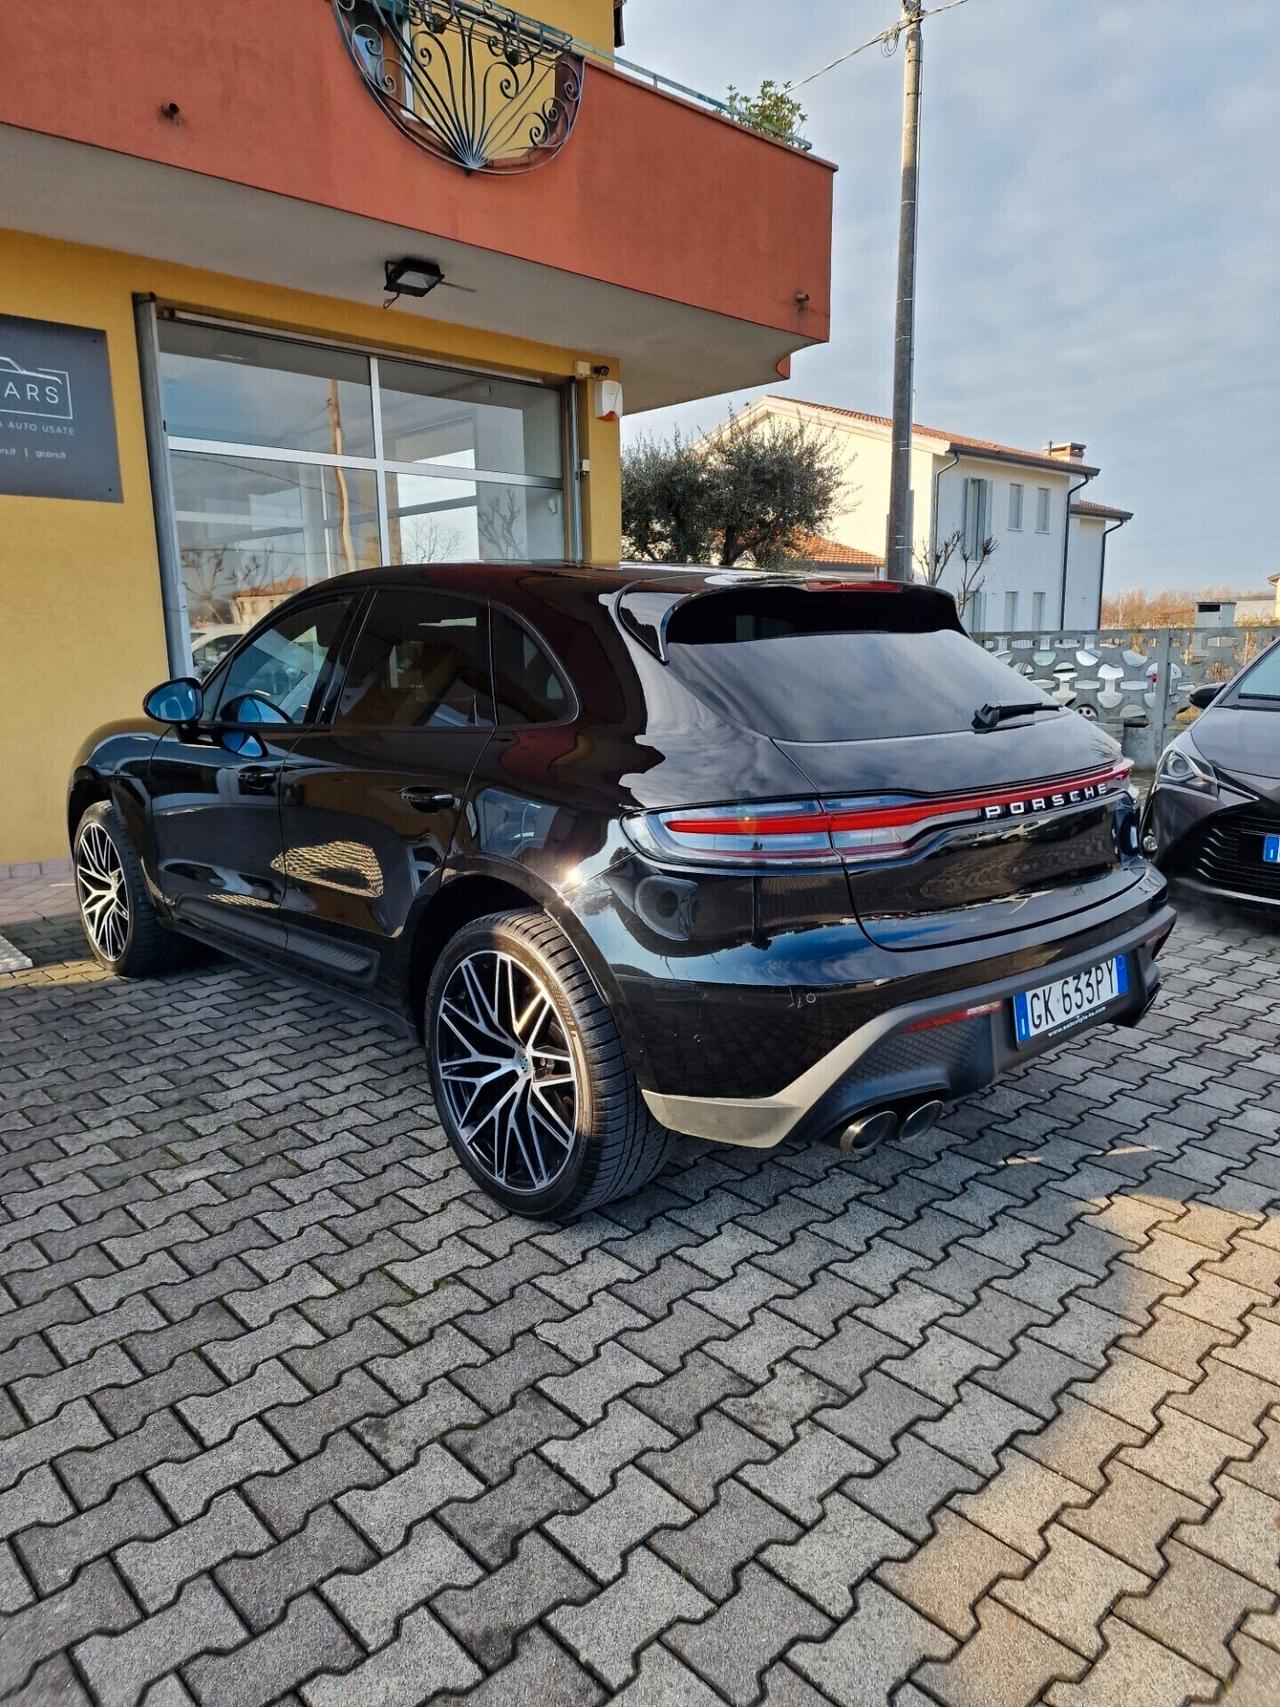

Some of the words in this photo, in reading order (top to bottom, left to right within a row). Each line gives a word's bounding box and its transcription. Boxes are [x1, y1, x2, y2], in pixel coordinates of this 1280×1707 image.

[8, 421, 38, 432] AUTO
[42, 425, 75, 436] USATE
[985, 783, 1107, 819] PORSCHE
[1030, 986, 1056, 1030] GK
[1061, 959, 1114, 1016] 633PY
